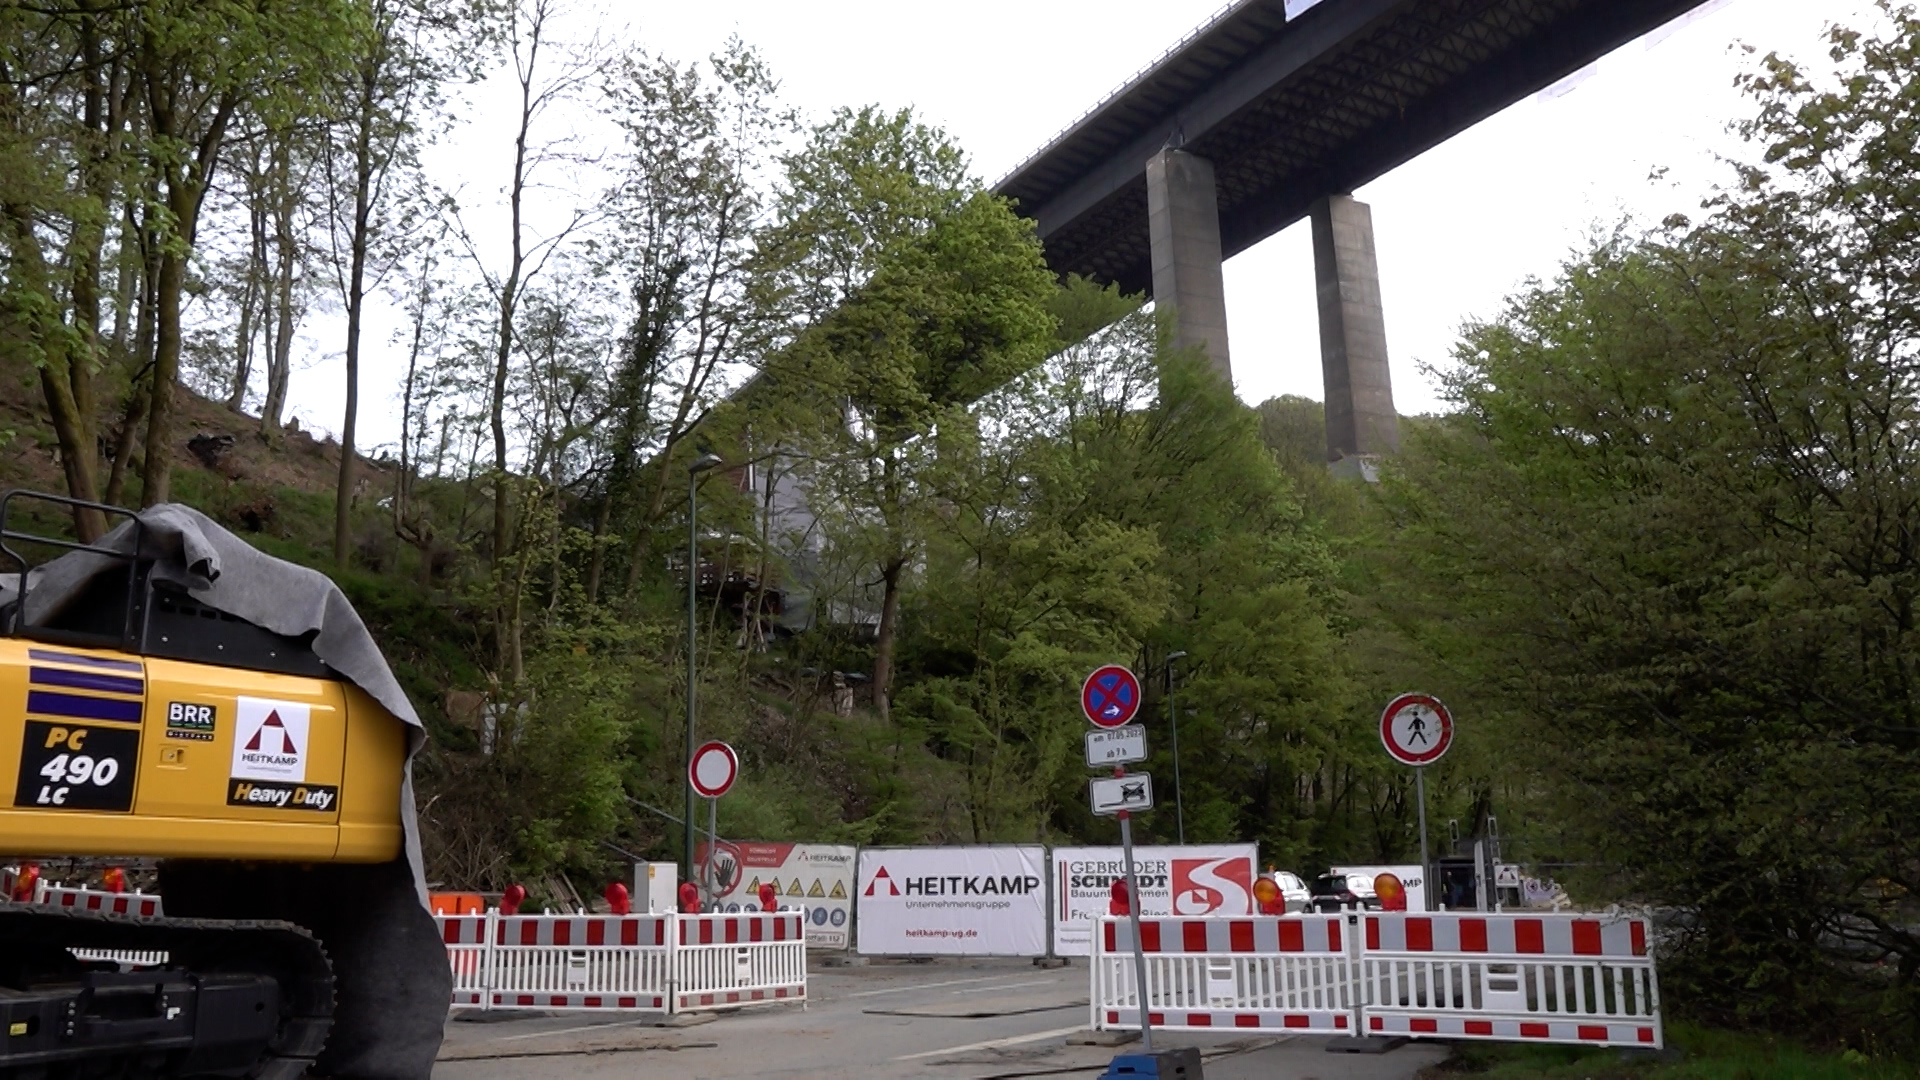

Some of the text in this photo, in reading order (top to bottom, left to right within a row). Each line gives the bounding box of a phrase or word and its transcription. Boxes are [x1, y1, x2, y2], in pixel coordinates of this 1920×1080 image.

[170, 703, 211, 724] BRR
[44, 727, 87, 750] PC
[242, 753, 298, 766] HEITKAMP
[40, 753, 118, 787] 490
[36, 787, 69, 805] LC
[233, 783, 334, 810] Heavy Duty
[906, 877, 1040, 896] HEITKAMP
[905, 901, 1011, 909] Unternehmensgruppe
[905, 929, 978, 938] heitkamp-ug.de
